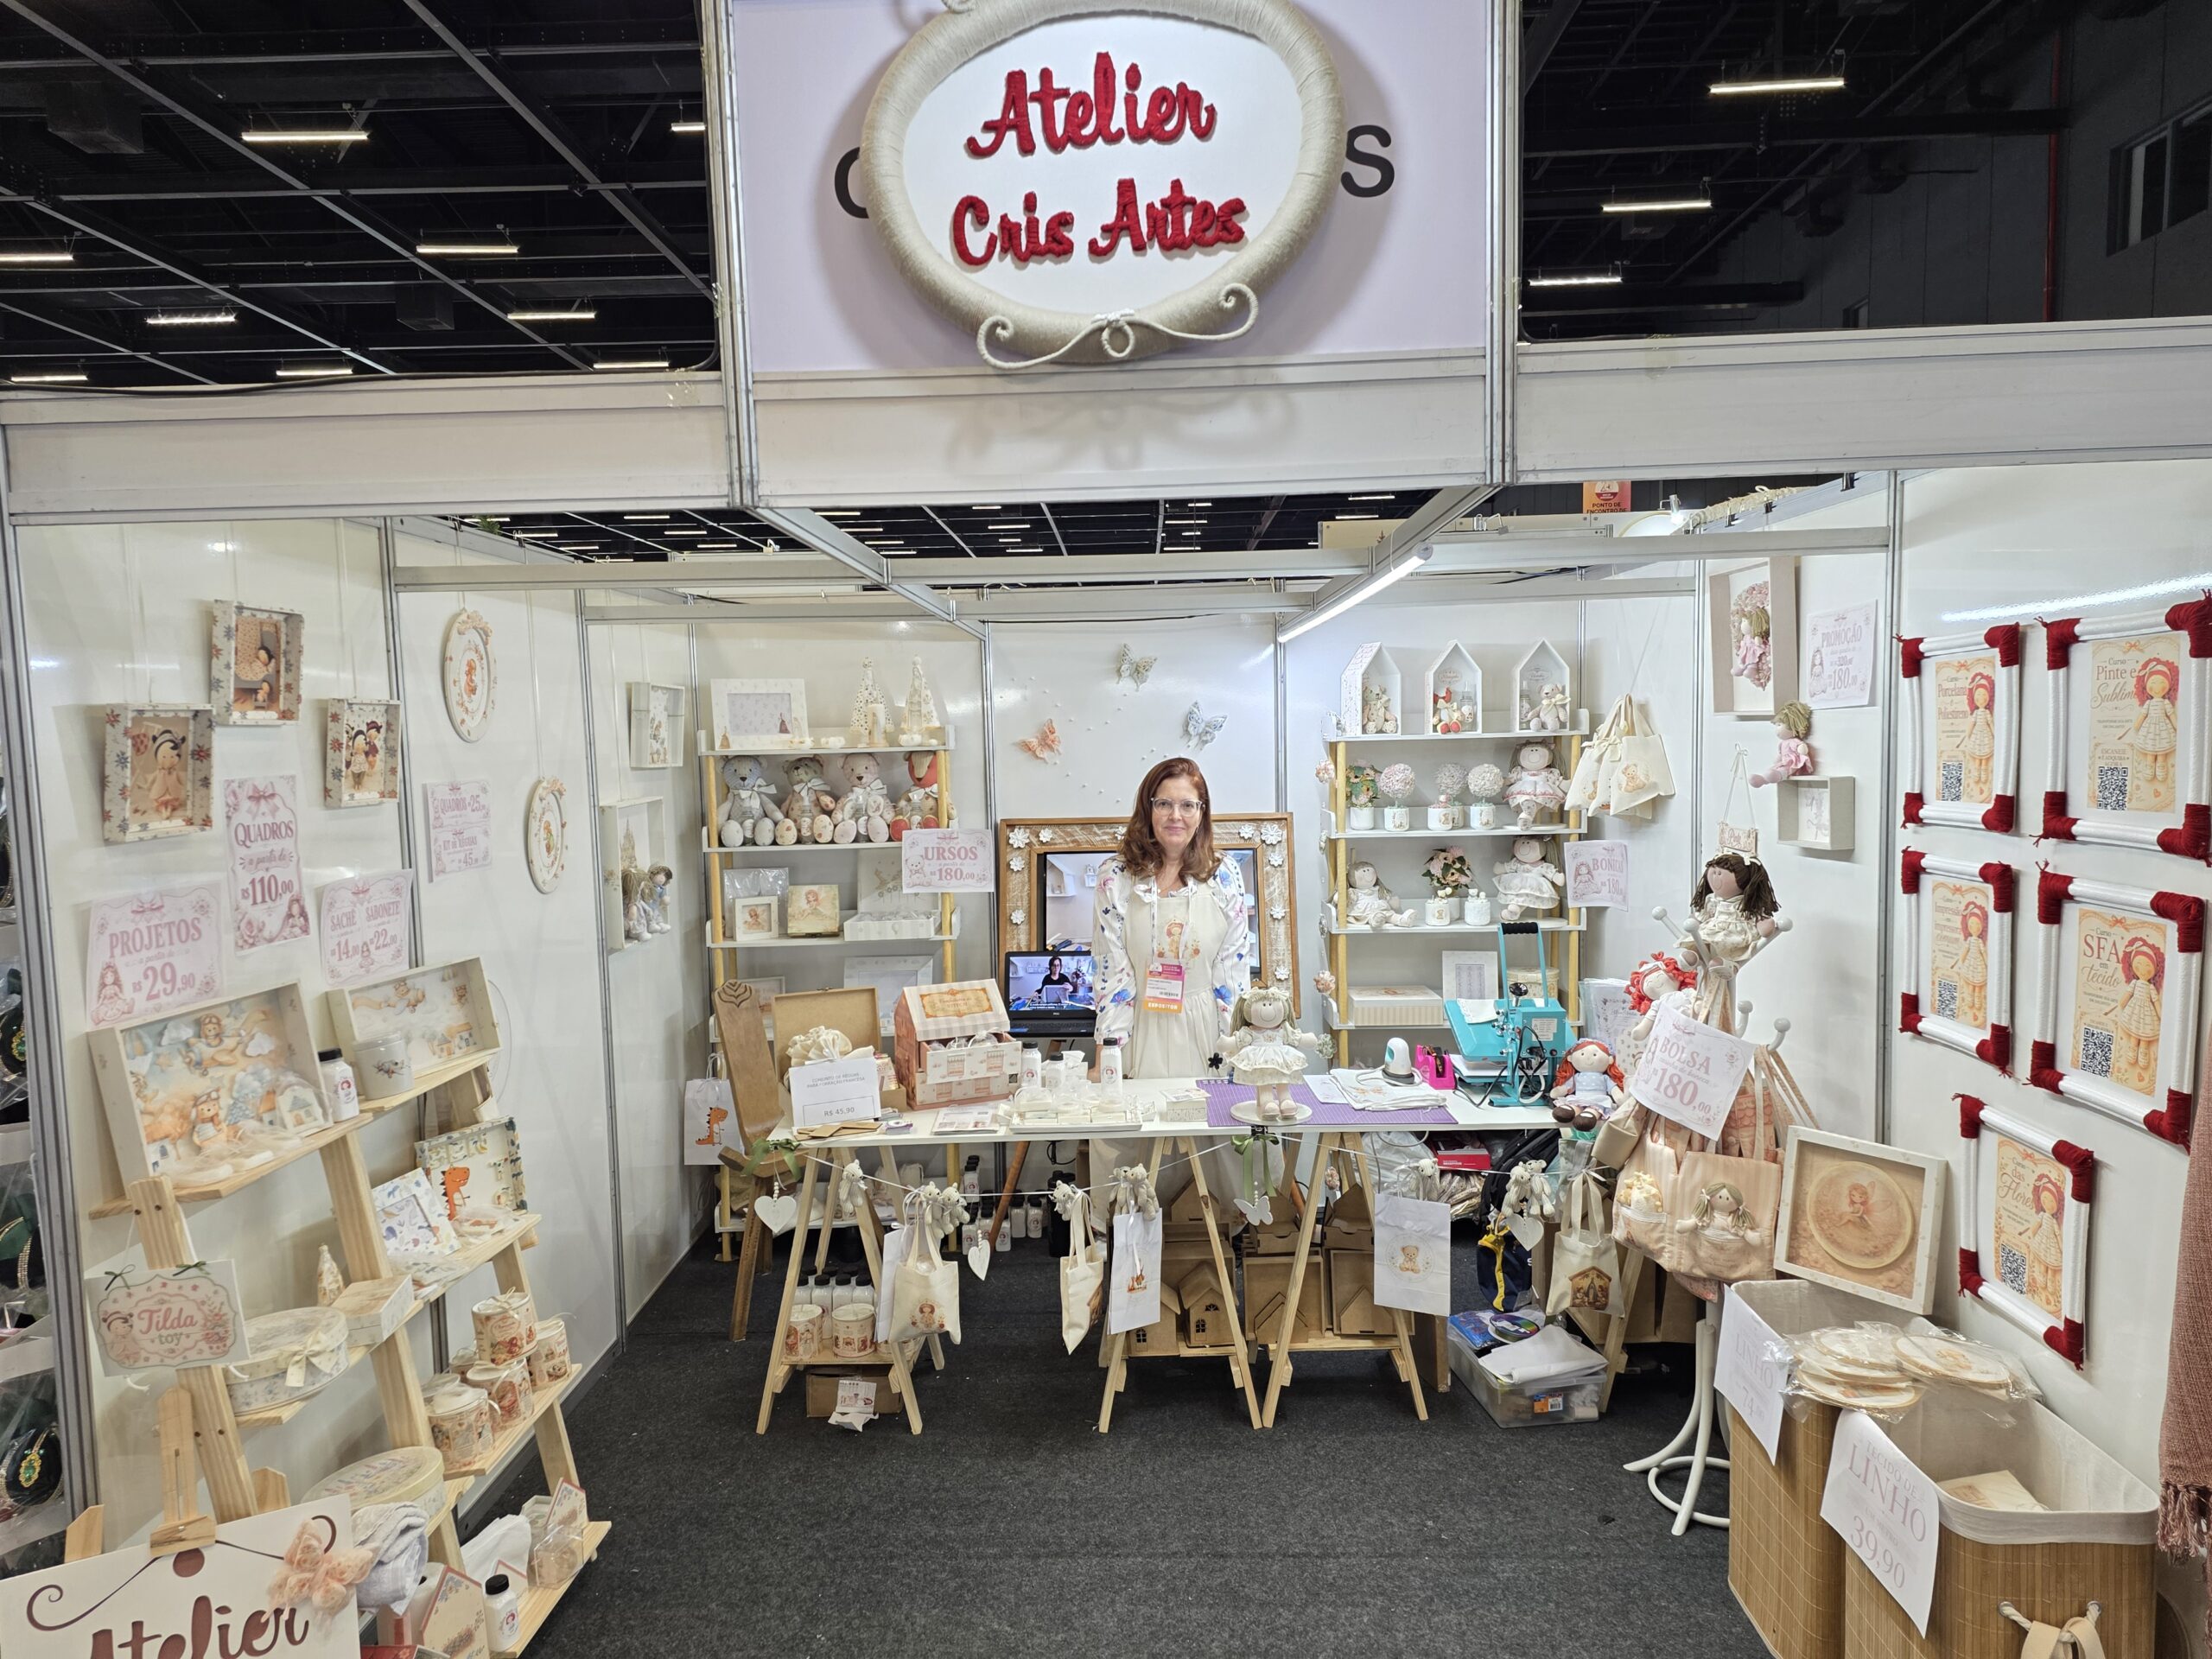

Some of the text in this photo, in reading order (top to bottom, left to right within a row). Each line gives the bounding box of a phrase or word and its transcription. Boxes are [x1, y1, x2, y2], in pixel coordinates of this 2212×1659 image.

[965, 51, 1217, 159] Atelier
[951, 178, 1247, 266] Cris Artes
[2096, 664, 2137, 681] Pinte e
[2108, 657, 2126, 665] Curso
[2090, 681, 2136, 709] Sublim
[440, 796, 467, 816] QUADROS
[234, 820, 295, 849] QUADROS
[924, 846, 978, 861] URSOS
[249, 874, 295, 906] 110,00
[937, 867, 976, 882] 180,00
[365, 899, 400, 923] SABONETE
[109, 917, 202, 959] PROJETOS
[2095, 927, 2112, 938] Curso
[2082, 933, 2122, 964] SFA
[143, 962, 195, 1001] 29,90
[2081, 963, 2122, 988] tecido
[1659, 1036, 1711, 1076] BOLSA
[1653, 1067, 1711, 1115] 180,00
[1997, 1173, 2034, 1211] Flores
[137, 1306, 199, 1335] Tilda
[158, 1332, 183, 1346] toy
[1735, 1332, 1773, 1389] LINHO
[1866, 1440, 1917, 1499] TECIDO DE
[1847, 1443, 1927, 1542] LINHO
[1850, 1515, 1906, 1589] 39,90
